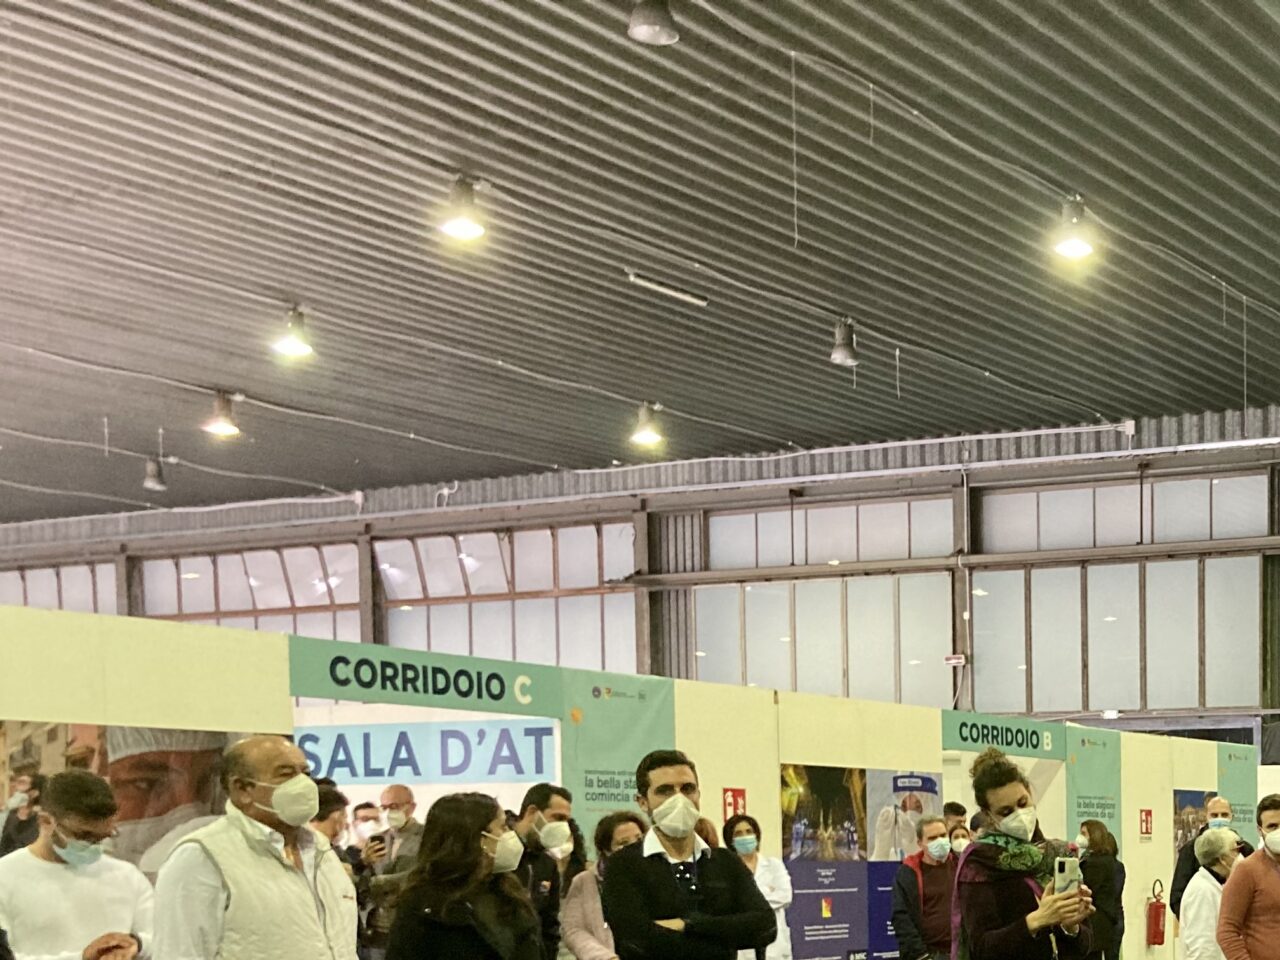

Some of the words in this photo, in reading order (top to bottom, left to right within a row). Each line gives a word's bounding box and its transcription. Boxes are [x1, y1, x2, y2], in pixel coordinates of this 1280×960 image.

[329, 655, 506, 701] CORRIDOIO
[513, 674, 533, 705] C
[959, 721, 1040, 750] CORRIDOIO
[1043, 731, 1052, 751] B
[298, 730, 422, 778] SALA
[440, 726, 554, 777] D'AT
[584, 776, 594, 788] la
[597, 776, 621, 790] bella
[585, 789, 630, 802] comincia
